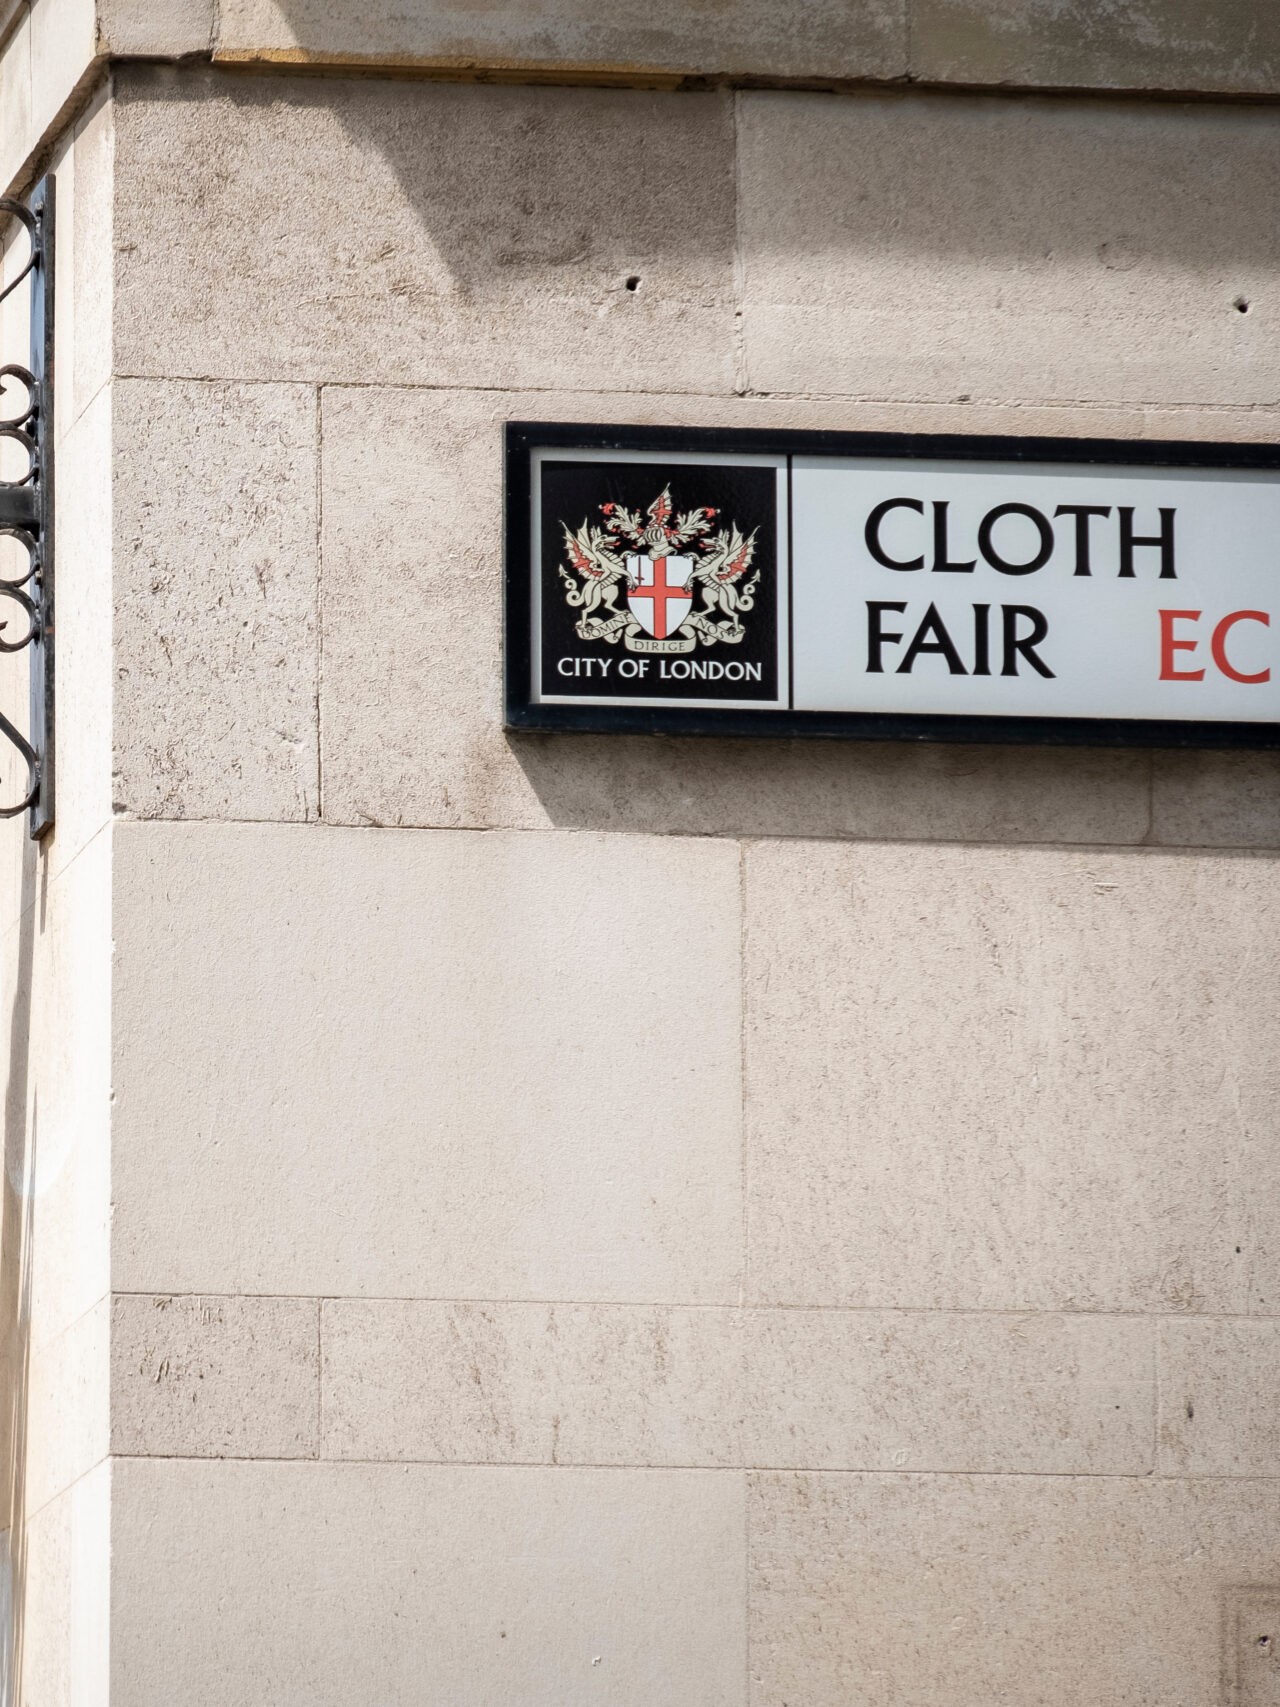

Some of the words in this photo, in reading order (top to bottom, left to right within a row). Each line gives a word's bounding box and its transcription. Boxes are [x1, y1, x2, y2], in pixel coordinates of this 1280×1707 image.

[864, 497, 1177, 579] CLOTH
[634, 640, 685, 652] DIRIGE
[865, 600, 1056, 679] FAIR
[1158, 609, 1271, 684] EC
[557, 657, 613, 677] CITY
[618, 658, 650, 678] OF
[660, 660, 762, 681] LONDON
